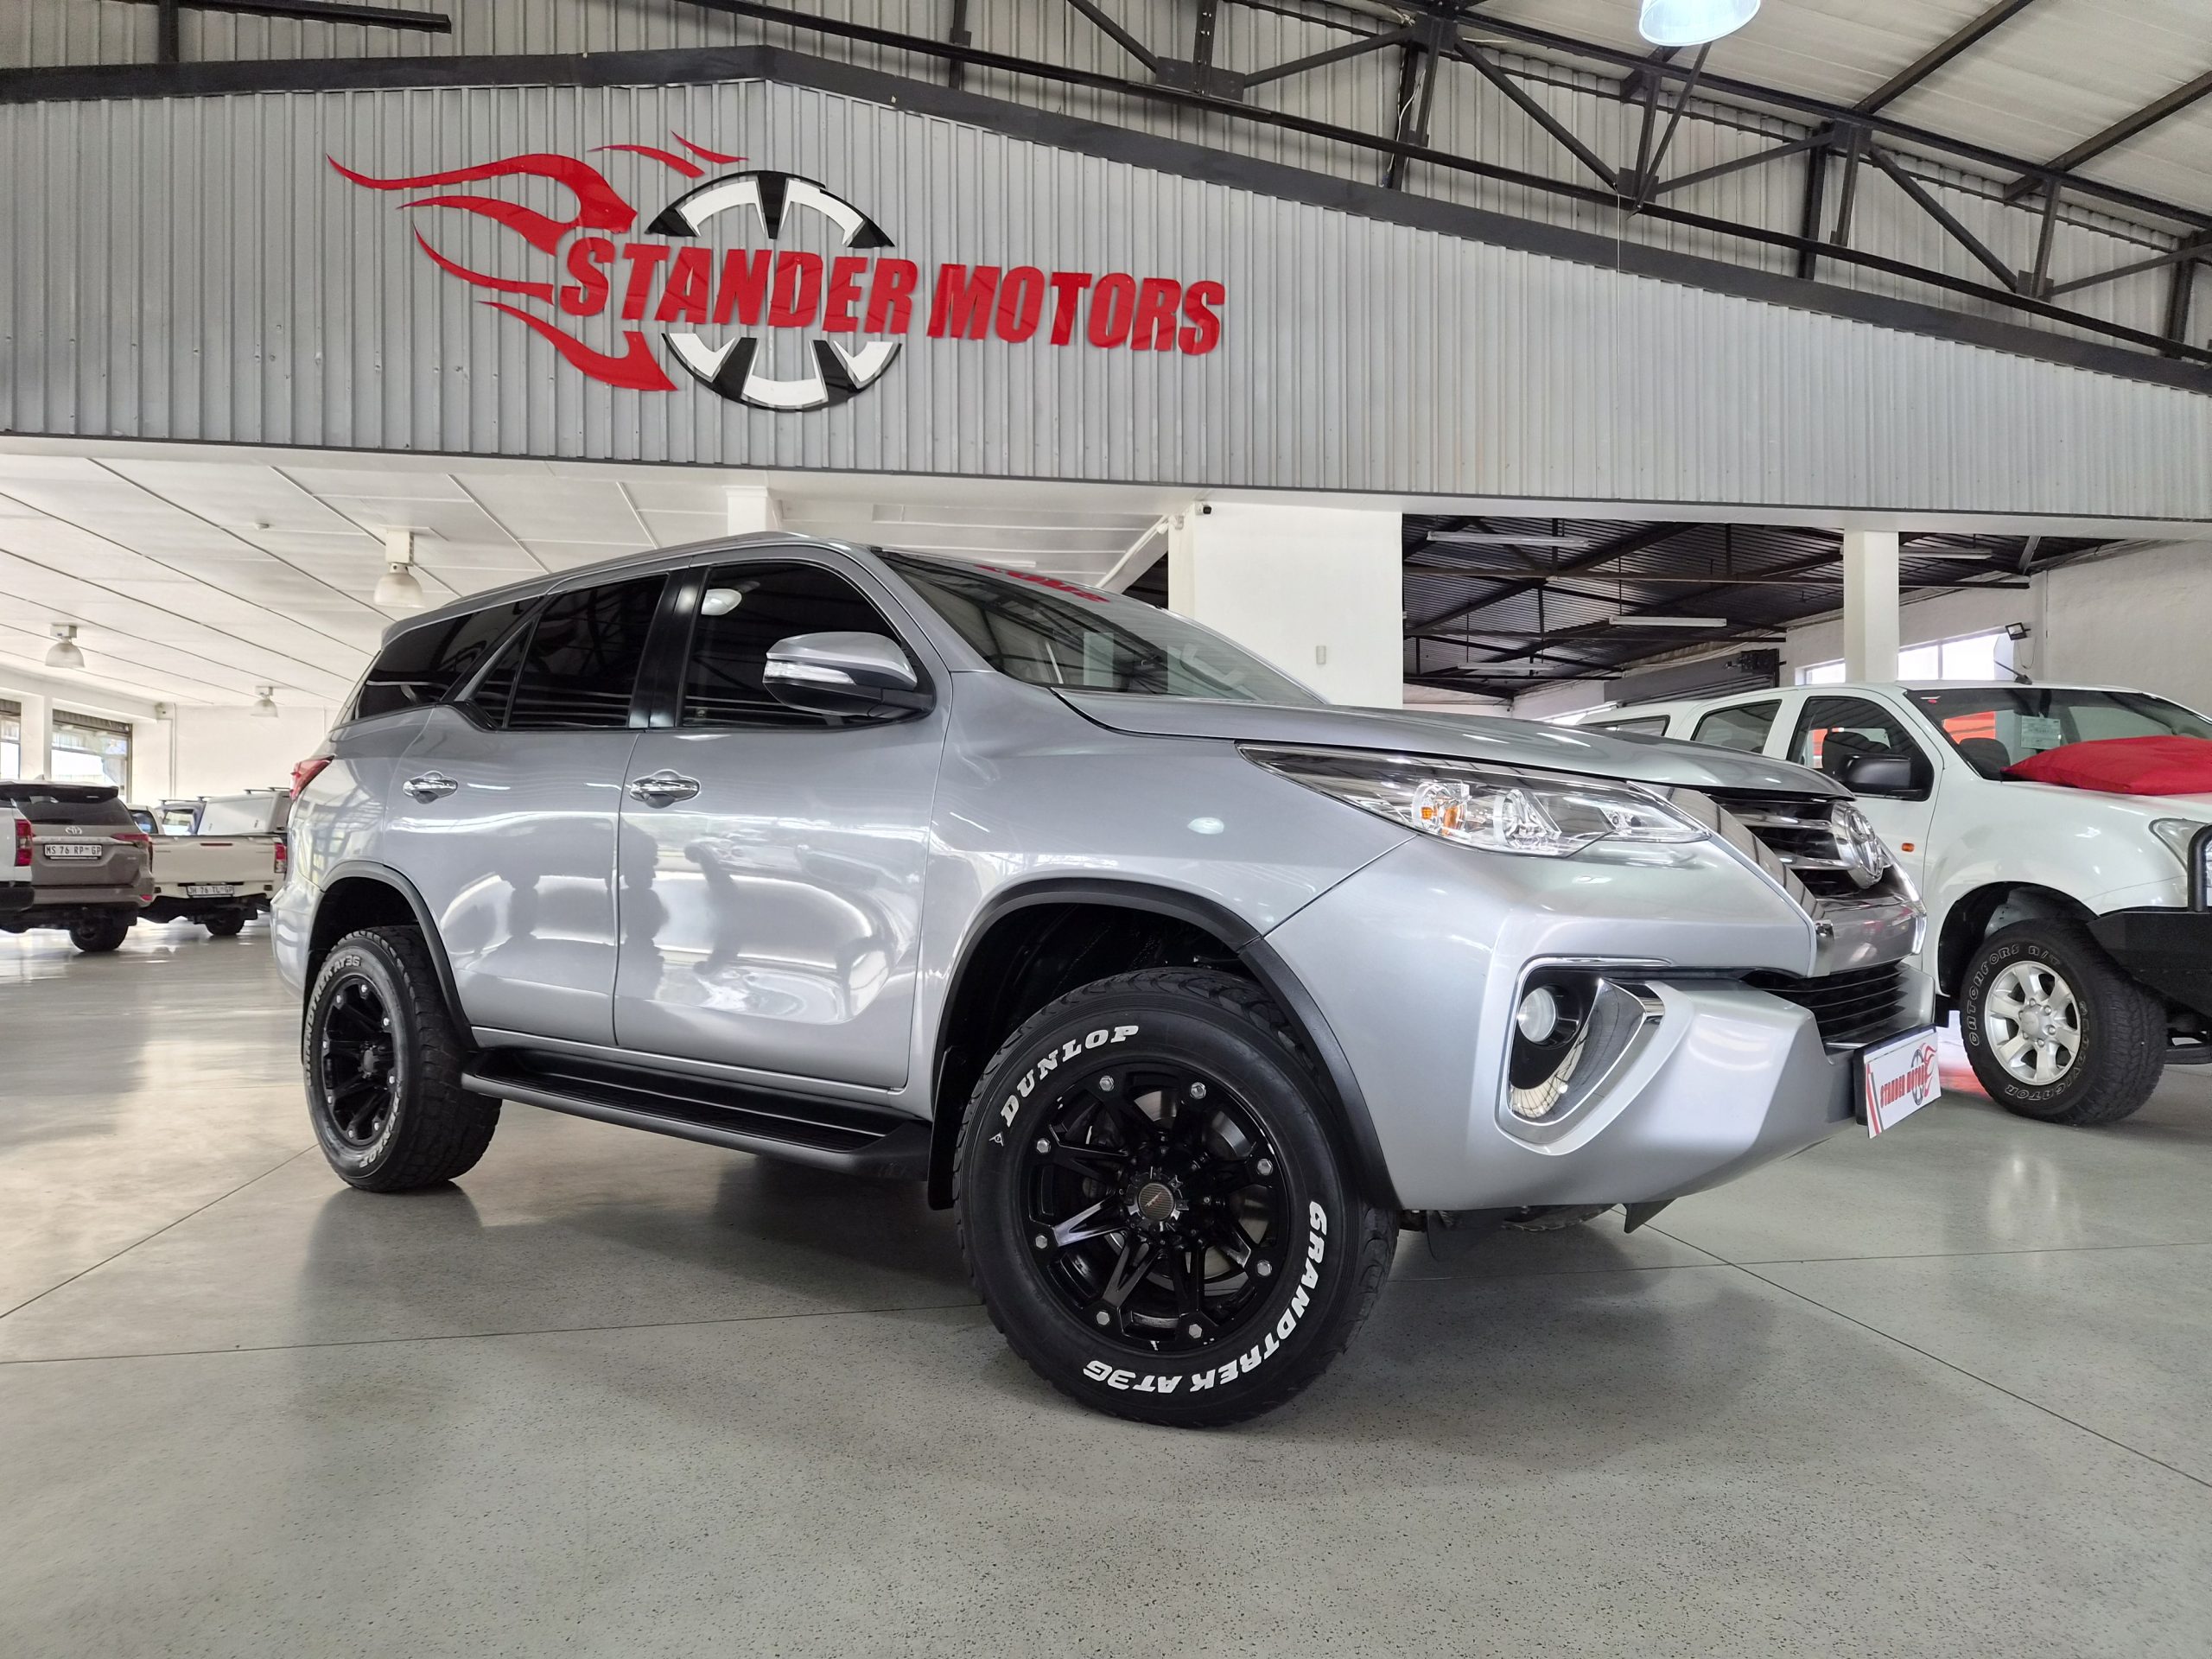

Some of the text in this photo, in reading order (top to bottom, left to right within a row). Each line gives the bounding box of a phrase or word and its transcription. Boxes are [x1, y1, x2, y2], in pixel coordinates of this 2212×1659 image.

[556, 236, 1225, 355] STANDER MOTORS
[60, 846, 69, 855] 76
[73, 846, 84, 855] RP
[92, 846, 101, 855] GP
[999, 1025, 1139, 1127] DUNLOP
[1083, 1200, 1327, 1394] GRANDTREK AT3G
